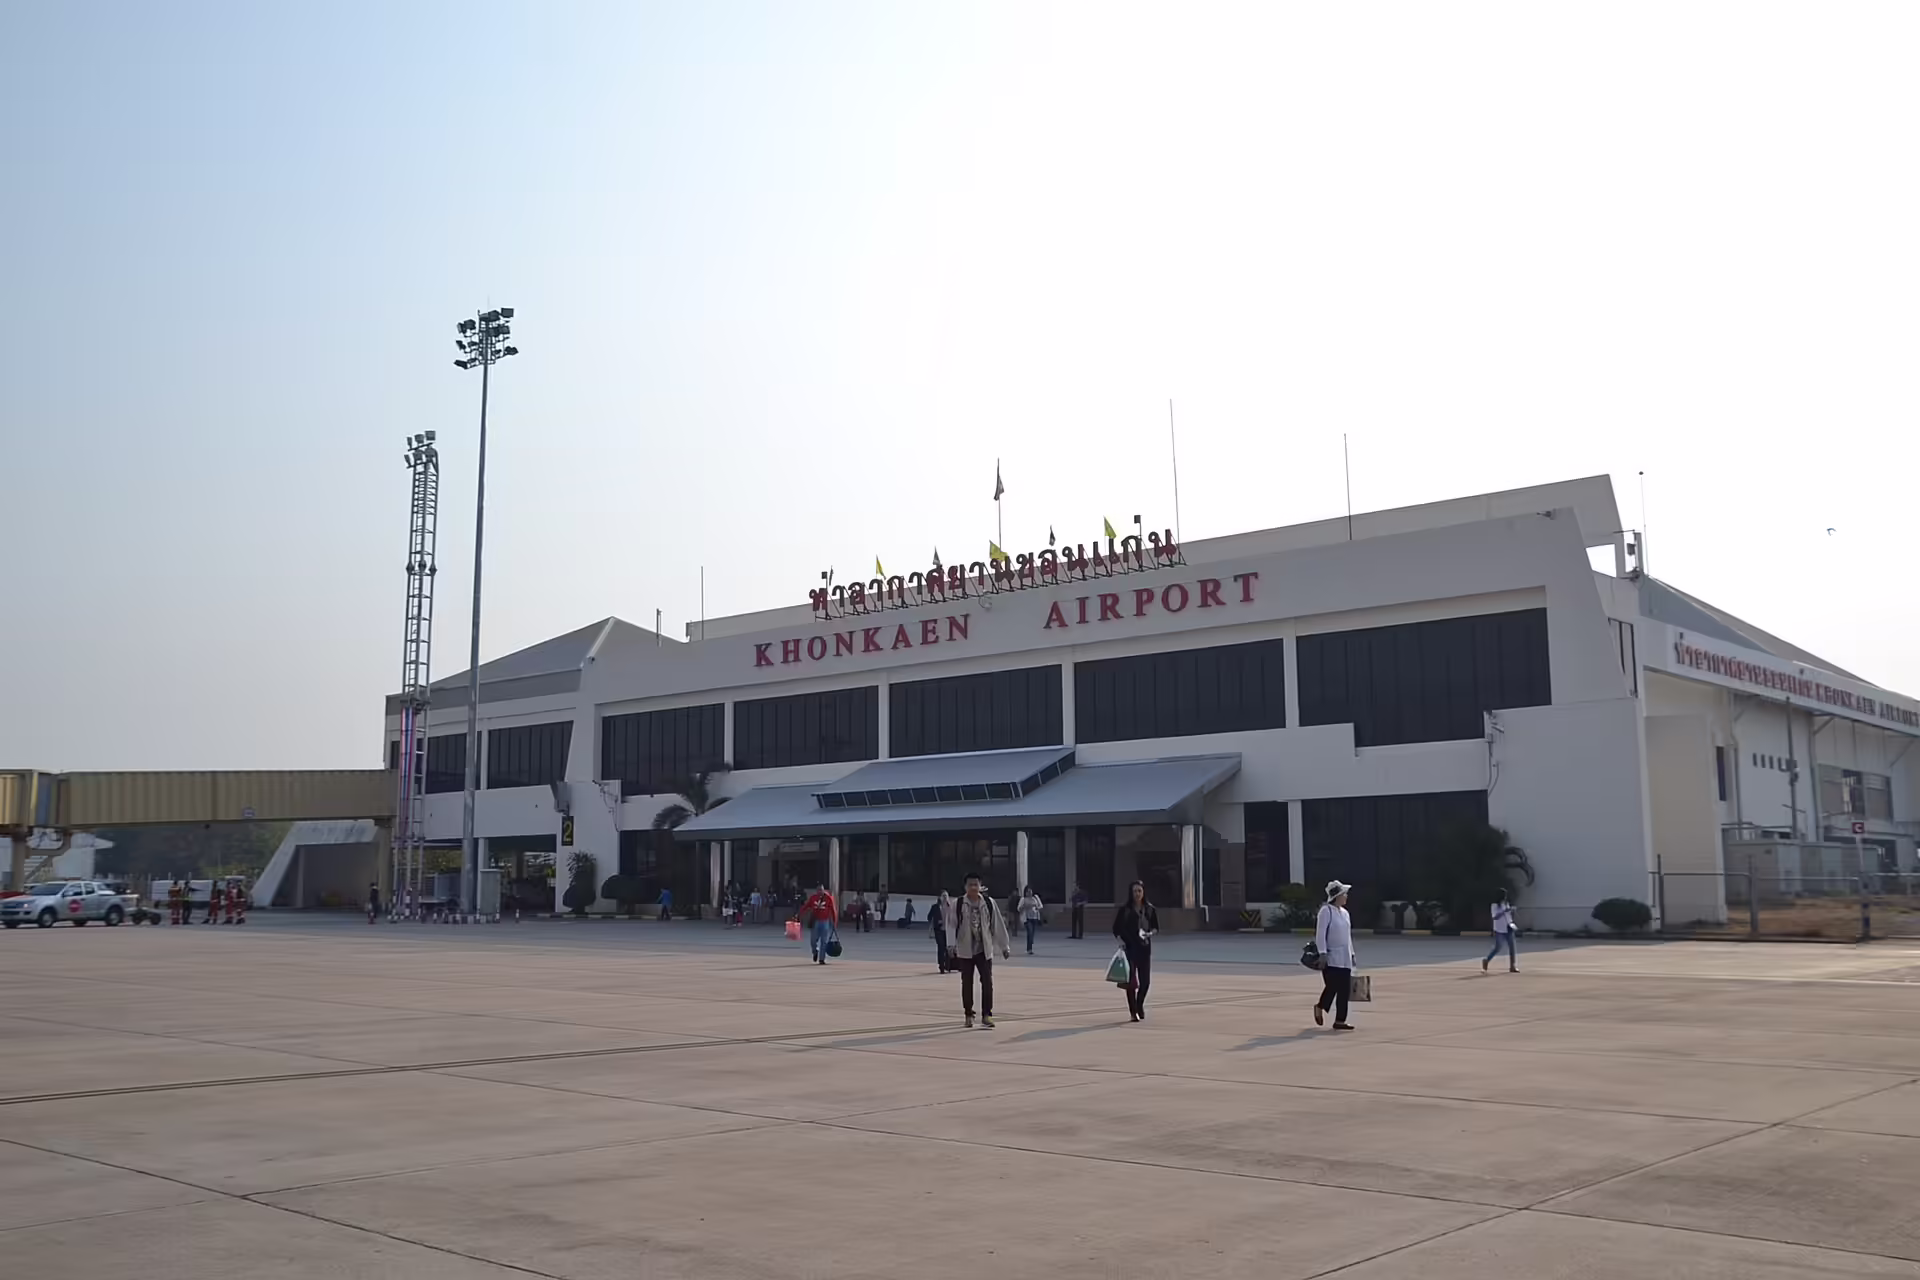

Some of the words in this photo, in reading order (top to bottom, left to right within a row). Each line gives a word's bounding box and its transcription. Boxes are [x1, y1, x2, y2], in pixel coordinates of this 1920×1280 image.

[809, 514, 1177, 612] ท่าอากาศยานขอนแก่น
[753, 613, 970, 668] KHONKAEN
[1043, 571, 1259, 629] AIRPORT
[563, 820, 573, 842] 2
